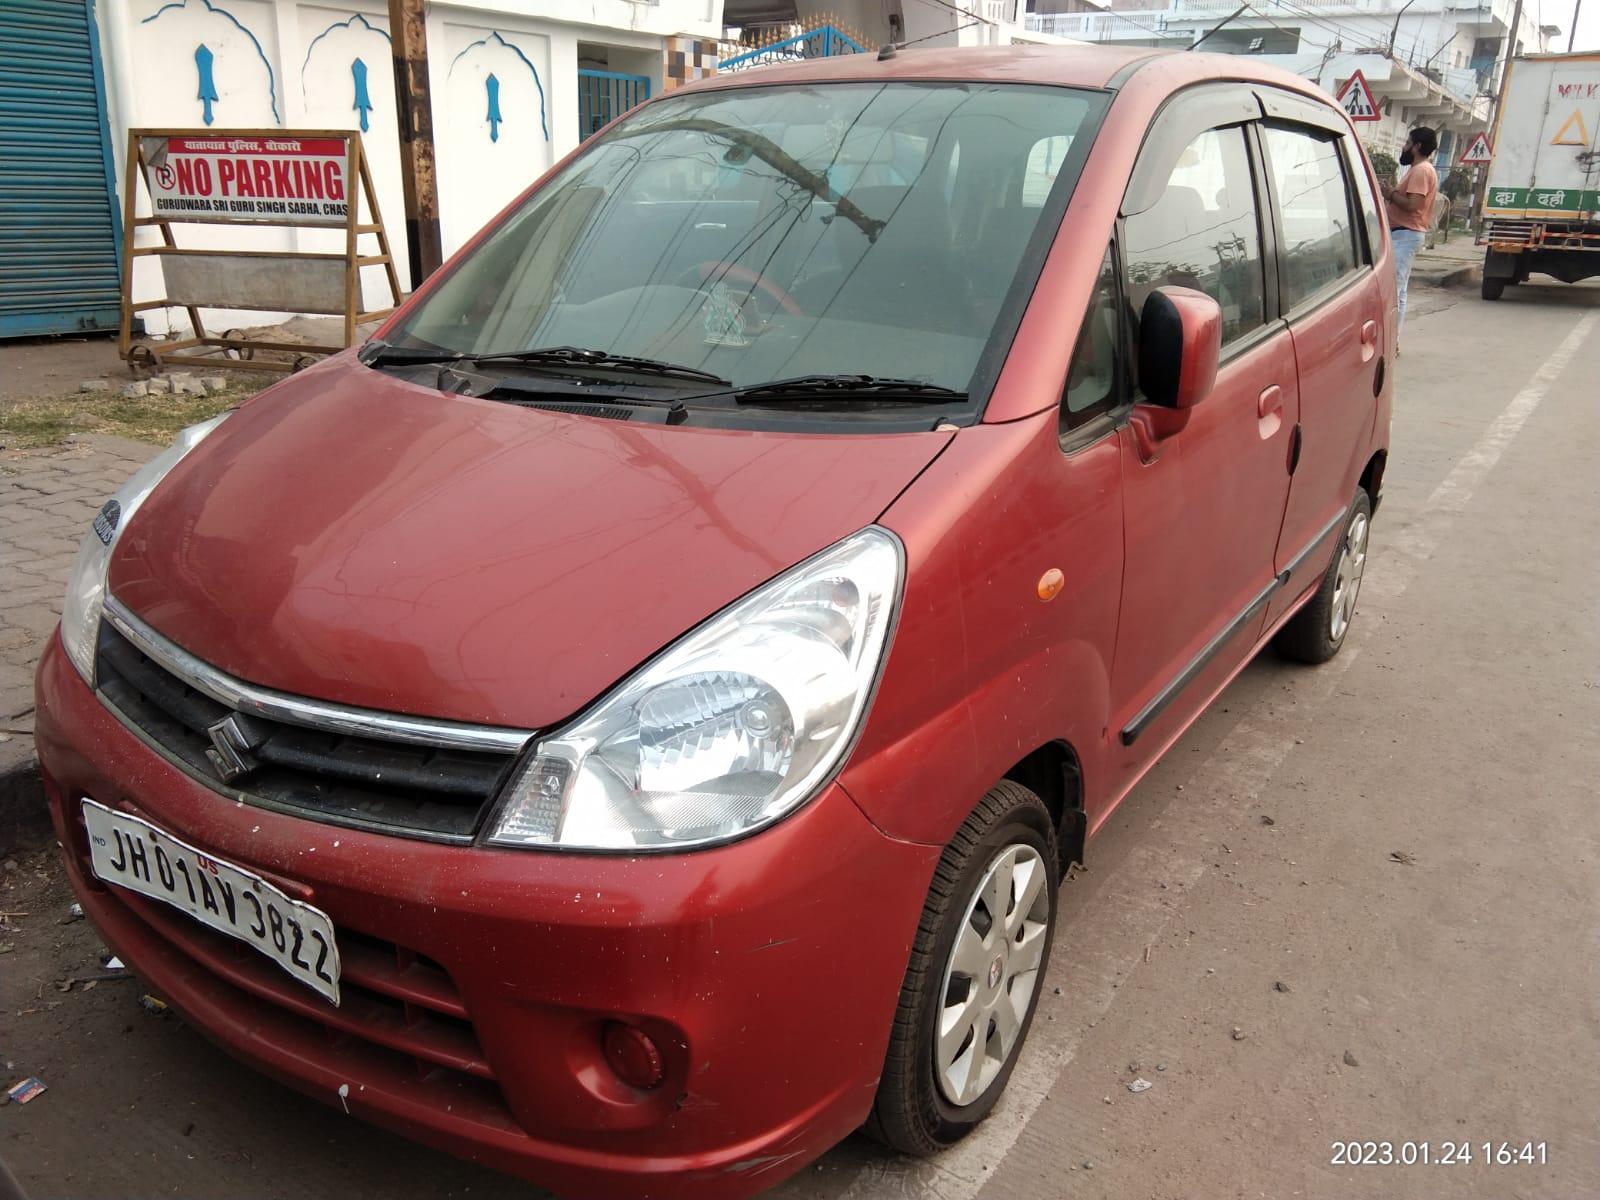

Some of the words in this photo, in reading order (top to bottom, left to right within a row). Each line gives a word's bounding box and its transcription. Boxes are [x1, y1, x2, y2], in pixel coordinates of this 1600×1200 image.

[175, 158, 212, 197] NO
[217, 159, 345, 201] PARKING
[157, 198, 212, 212] GURUDWARA
[213, 200, 228, 212] SRI
[230, 200, 255, 213] GURU
[256, 200, 287, 214] SINGH
[288, 202, 322, 216] SABHA,
[92, 835, 106, 847] IND
